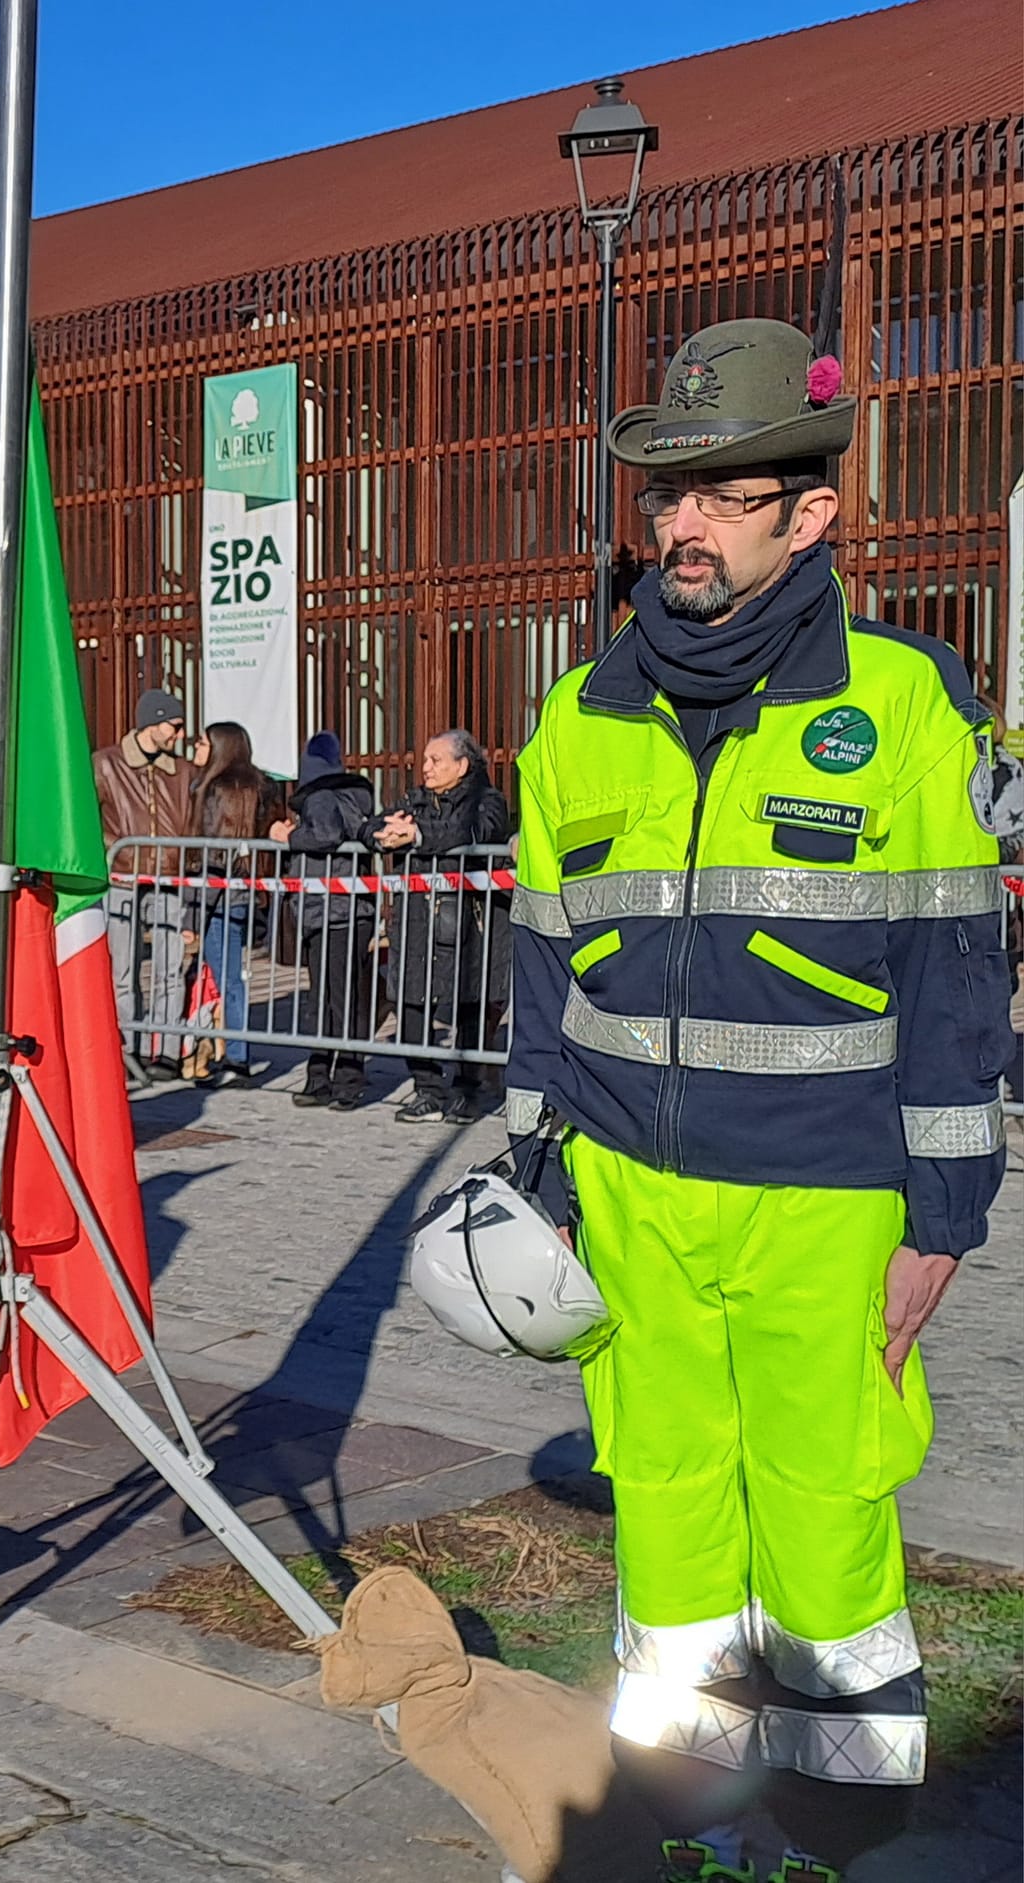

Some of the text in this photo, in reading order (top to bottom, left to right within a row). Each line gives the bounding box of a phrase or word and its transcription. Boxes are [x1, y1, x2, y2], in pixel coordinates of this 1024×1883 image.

[233, 430, 276, 459] PIEVE
[210, 535, 282, 572] SPA
[210, 571, 272, 605] ZIO
[822, 750, 861, 764] ALPINI
[769, 800, 858, 825] MARZORATI M.
